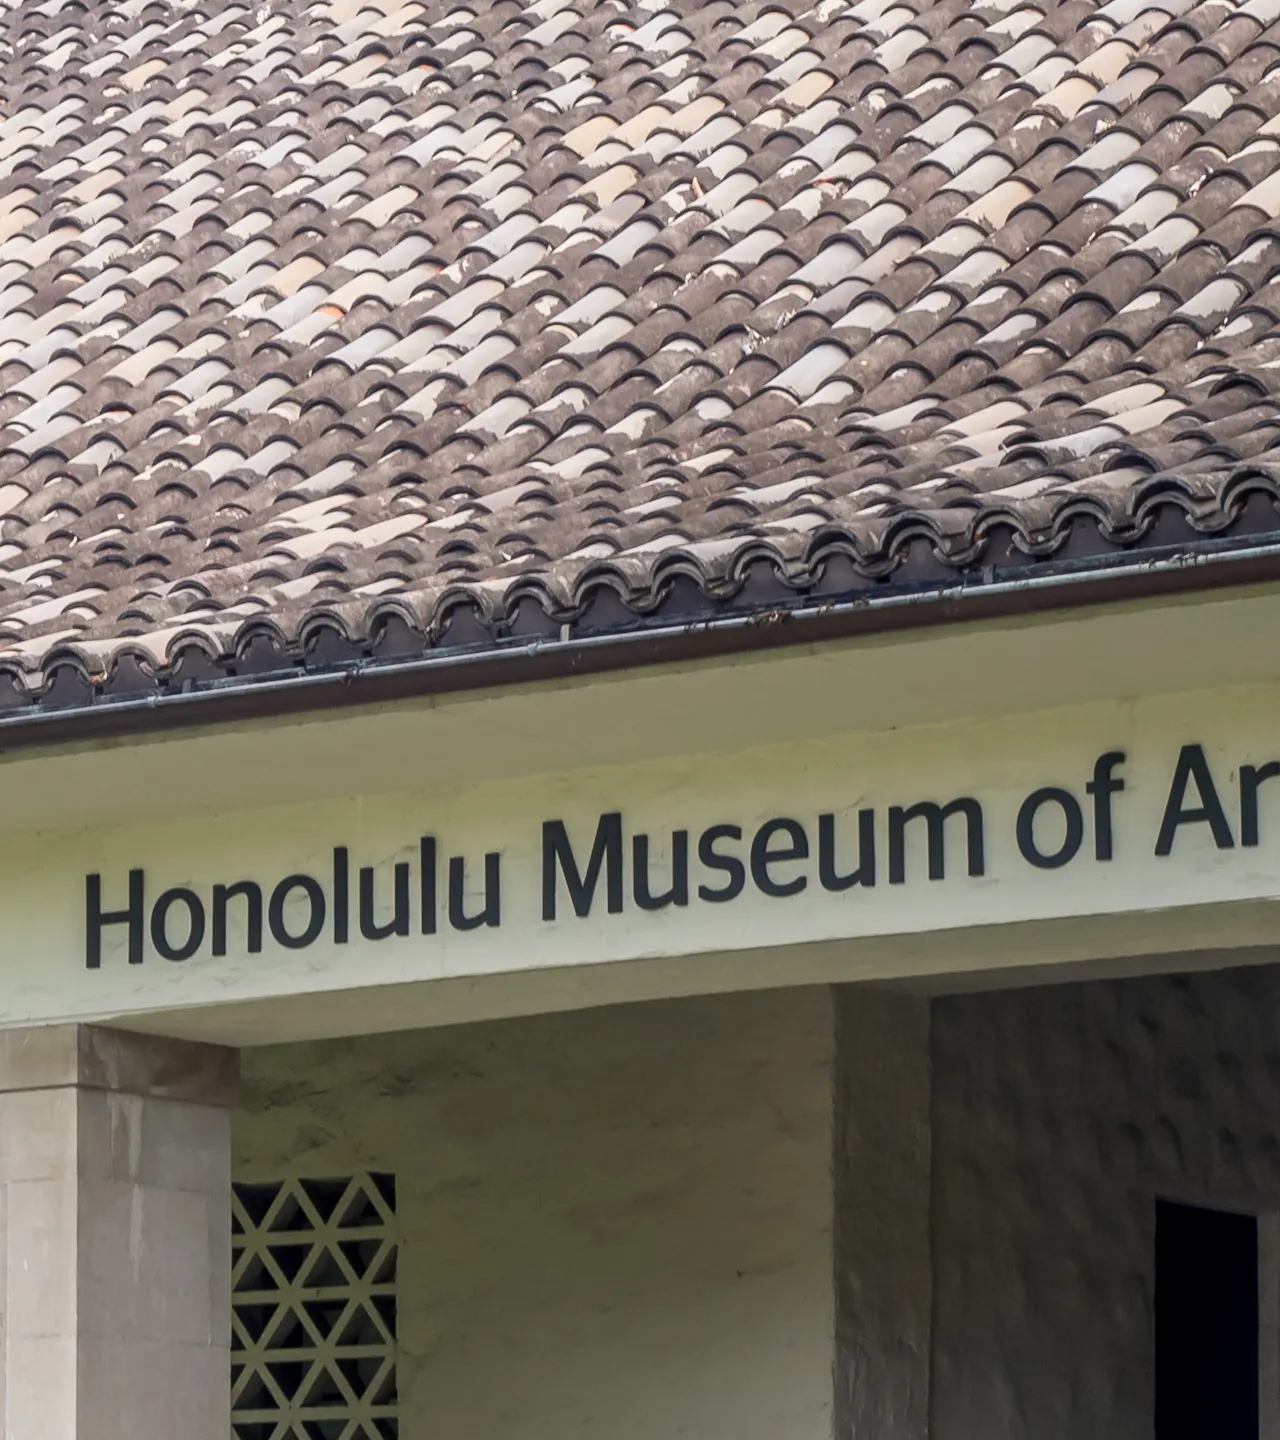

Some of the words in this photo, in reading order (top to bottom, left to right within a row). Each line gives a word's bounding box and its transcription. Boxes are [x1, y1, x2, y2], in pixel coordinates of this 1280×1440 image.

[84, 836, 501, 969] Honolulu
[541, 798, 985, 920] Museum
[1017, 751, 1125, 870] of
